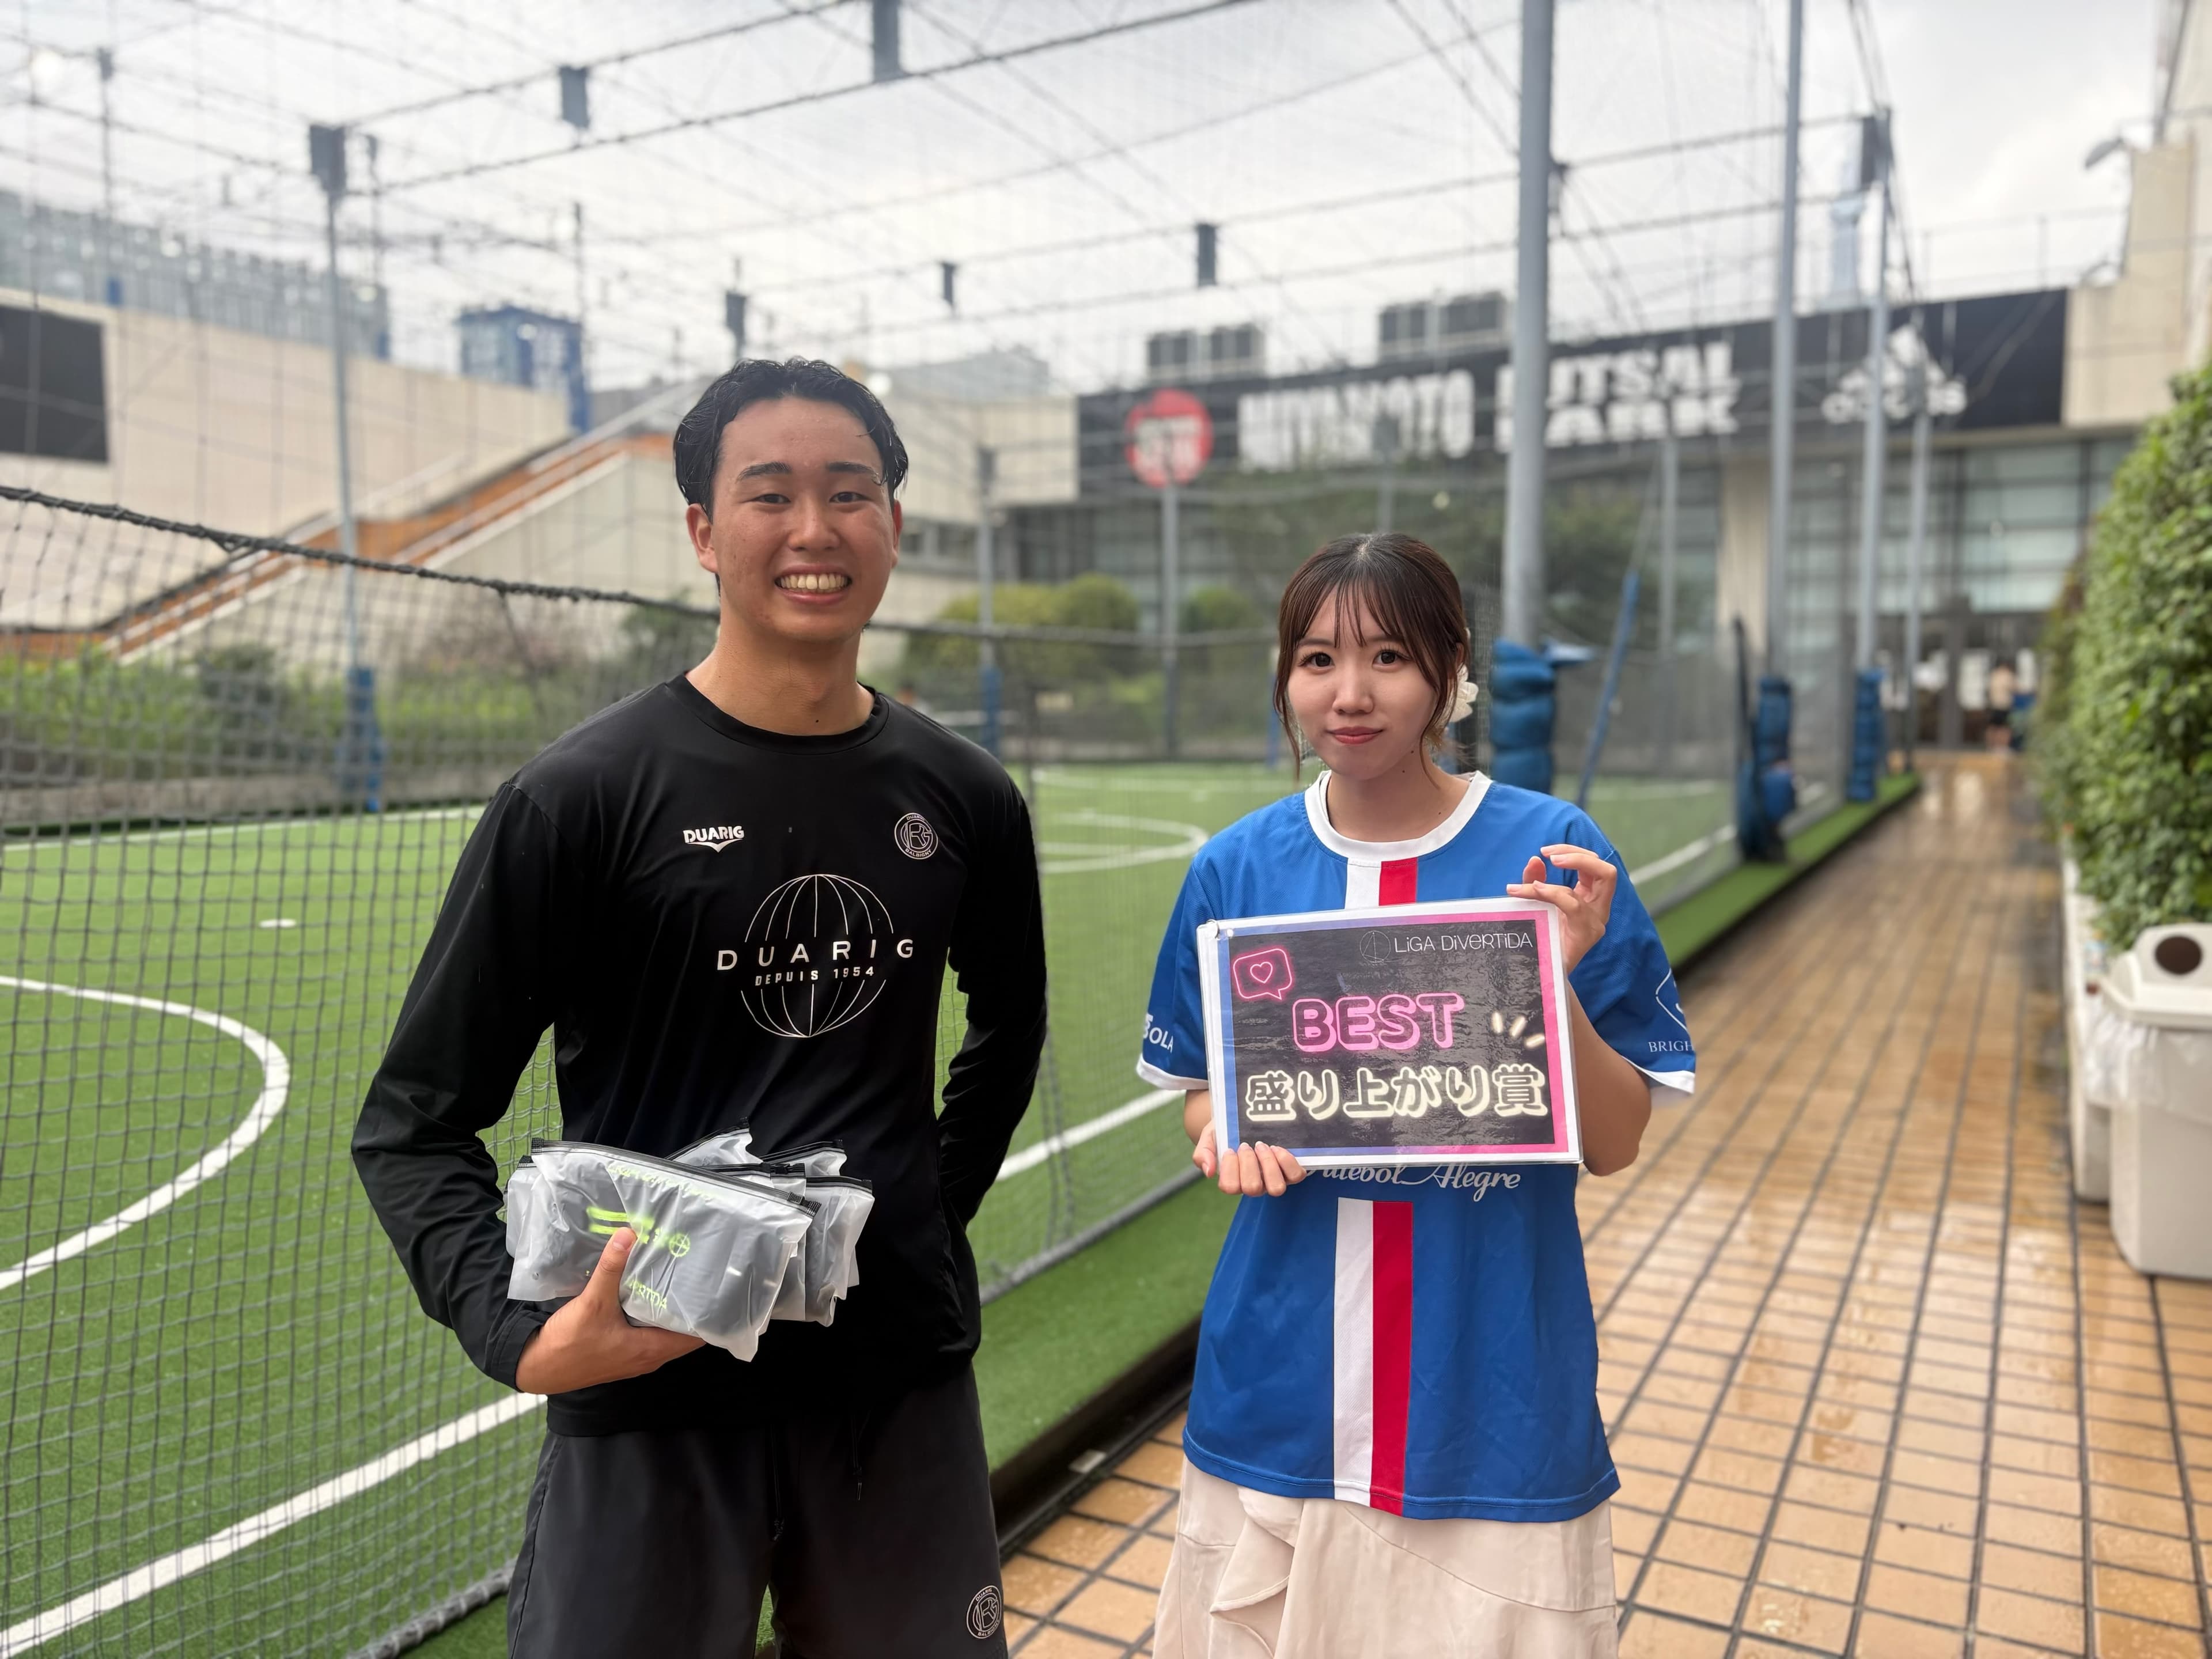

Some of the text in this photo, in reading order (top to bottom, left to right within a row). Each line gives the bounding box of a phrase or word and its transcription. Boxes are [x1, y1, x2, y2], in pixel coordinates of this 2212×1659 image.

[683, 825, 744, 843] DUARIG
[717, 940, 914, 971] DUARIG
[755, 966, 874, 986] DEPUIS 1954
[1291, 992, 1465, 1052] BEST
[1245, 1063, 1548, 1122] 盛り上がり賞
[1305, 1164, 1403, 1185] uebol
